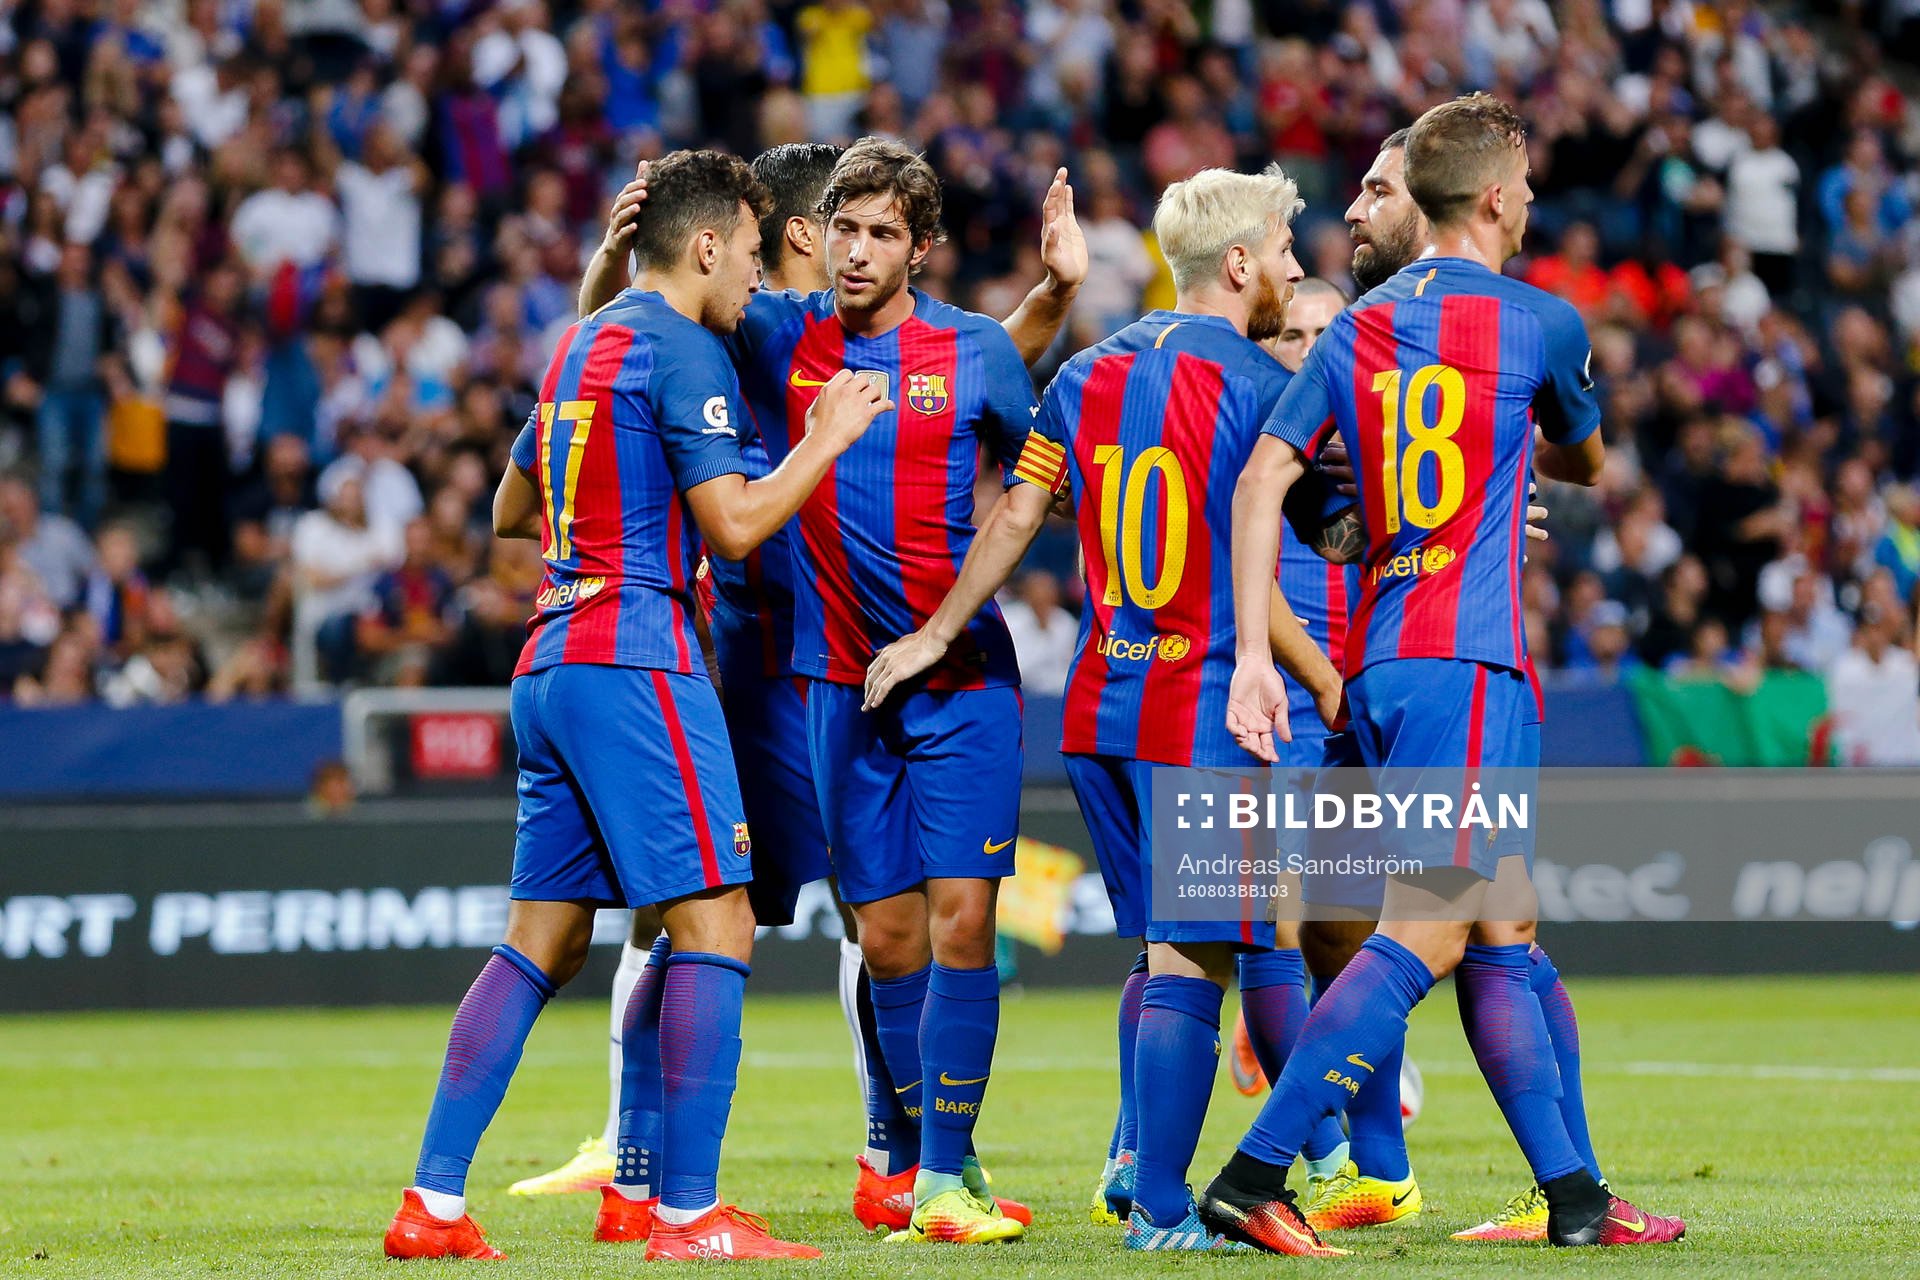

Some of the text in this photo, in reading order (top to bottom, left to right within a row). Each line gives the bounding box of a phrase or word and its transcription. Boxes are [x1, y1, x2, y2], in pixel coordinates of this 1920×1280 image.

[541, 400, 597, 560] 17
[1093, 444, 1188, 610] 10
[1371, 364, 1466, 535] 18
[0, 894, 137, 958] RT
[150, 885, 511, 956] PERIME
[1323, 1069, 1361, 1098] BAR
